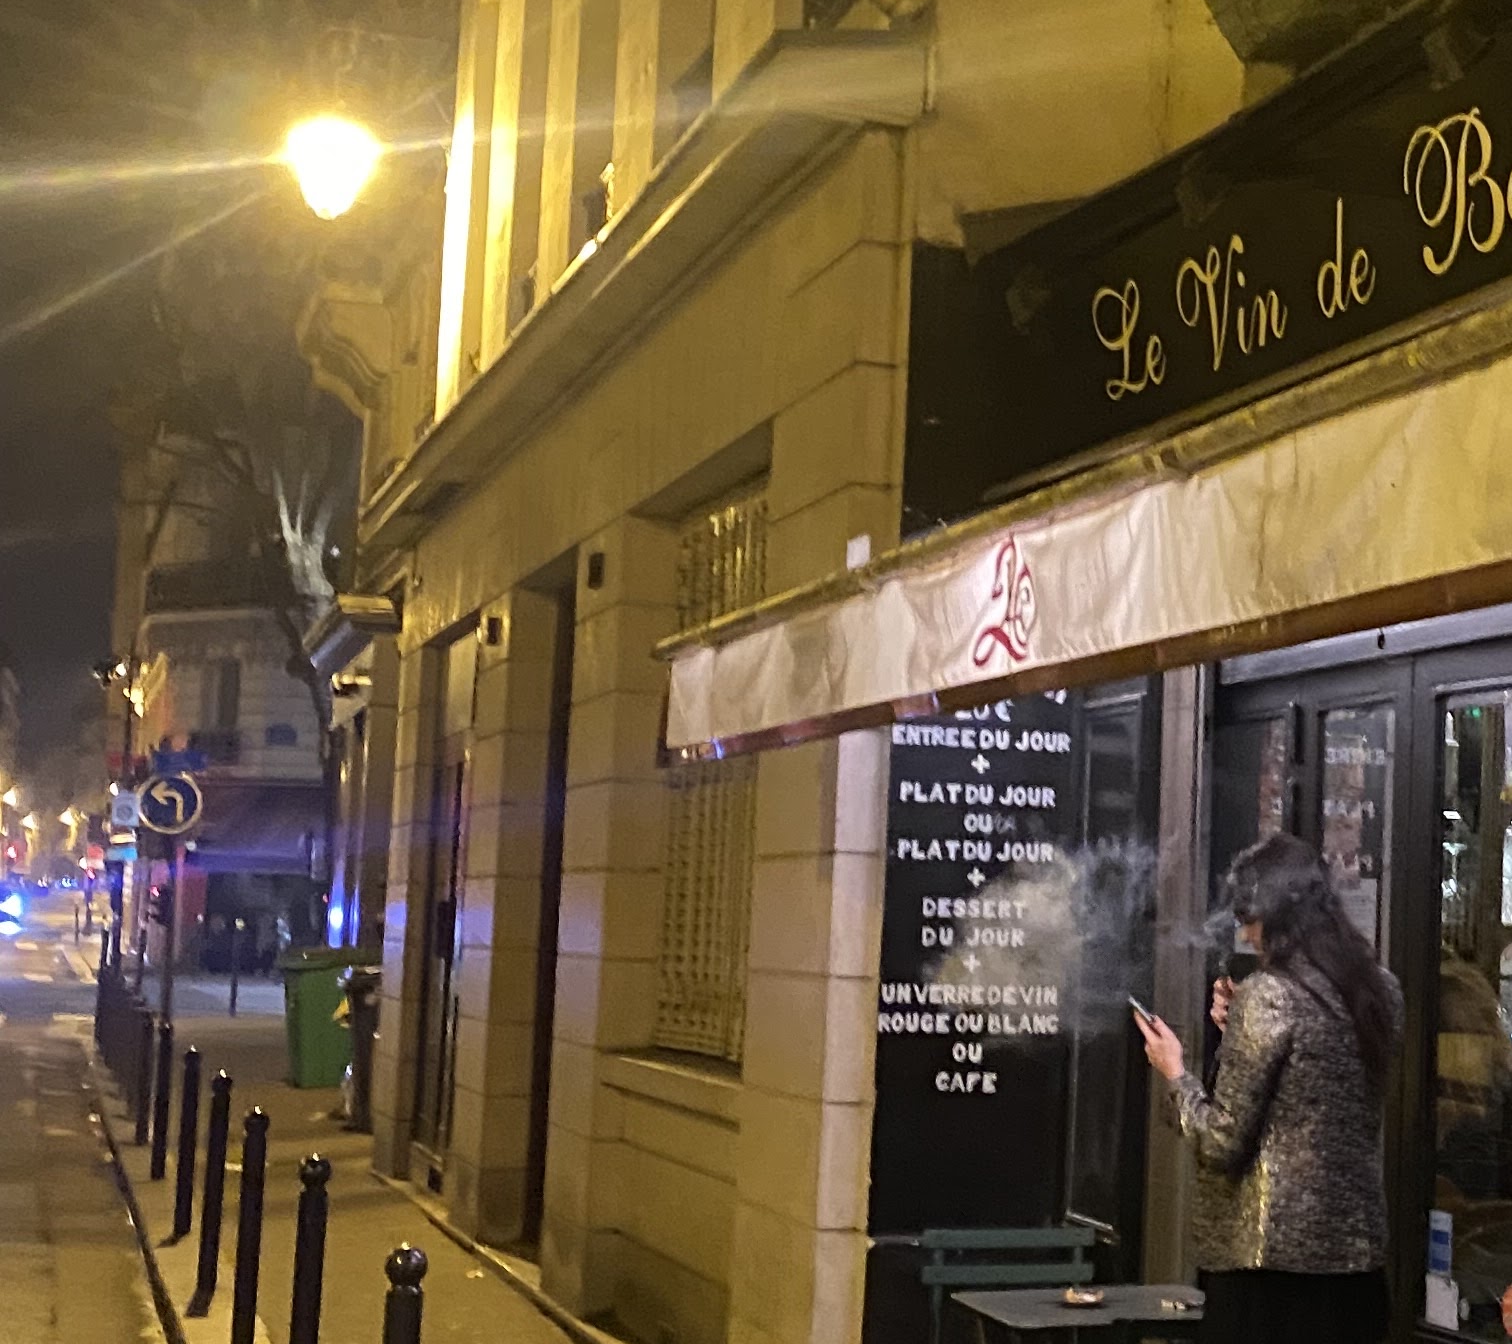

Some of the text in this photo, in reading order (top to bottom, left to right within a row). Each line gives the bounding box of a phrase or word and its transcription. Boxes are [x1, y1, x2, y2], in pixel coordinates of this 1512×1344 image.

[1092, 278, 1167, 401] Le
[1176, 233, 1288, 372] Vin
[1317, 196, 1376, 319] de
[979, 729, 1010, 750] DU
[1014, 729, 1071, 753] JOUR
[899, 781, 1056, 807] PLAT DU JOUR
[963, 812, 994, 833] OU
[898, 838, 1053, 862] PLAT DU JOUR
[921, 896, 1025, 919] DESSERT
[921, 926, 1026, 948] DU JOUR
[881, 982, 1058, 1006] UN VERRE DE VIN
[878, 1012, 950, 1034] ROUGE
[954, 1013, 984, 1034] OU
[952, 1042, 984, 1065] OU
[935, 1070, 999, 1094] CAFE
